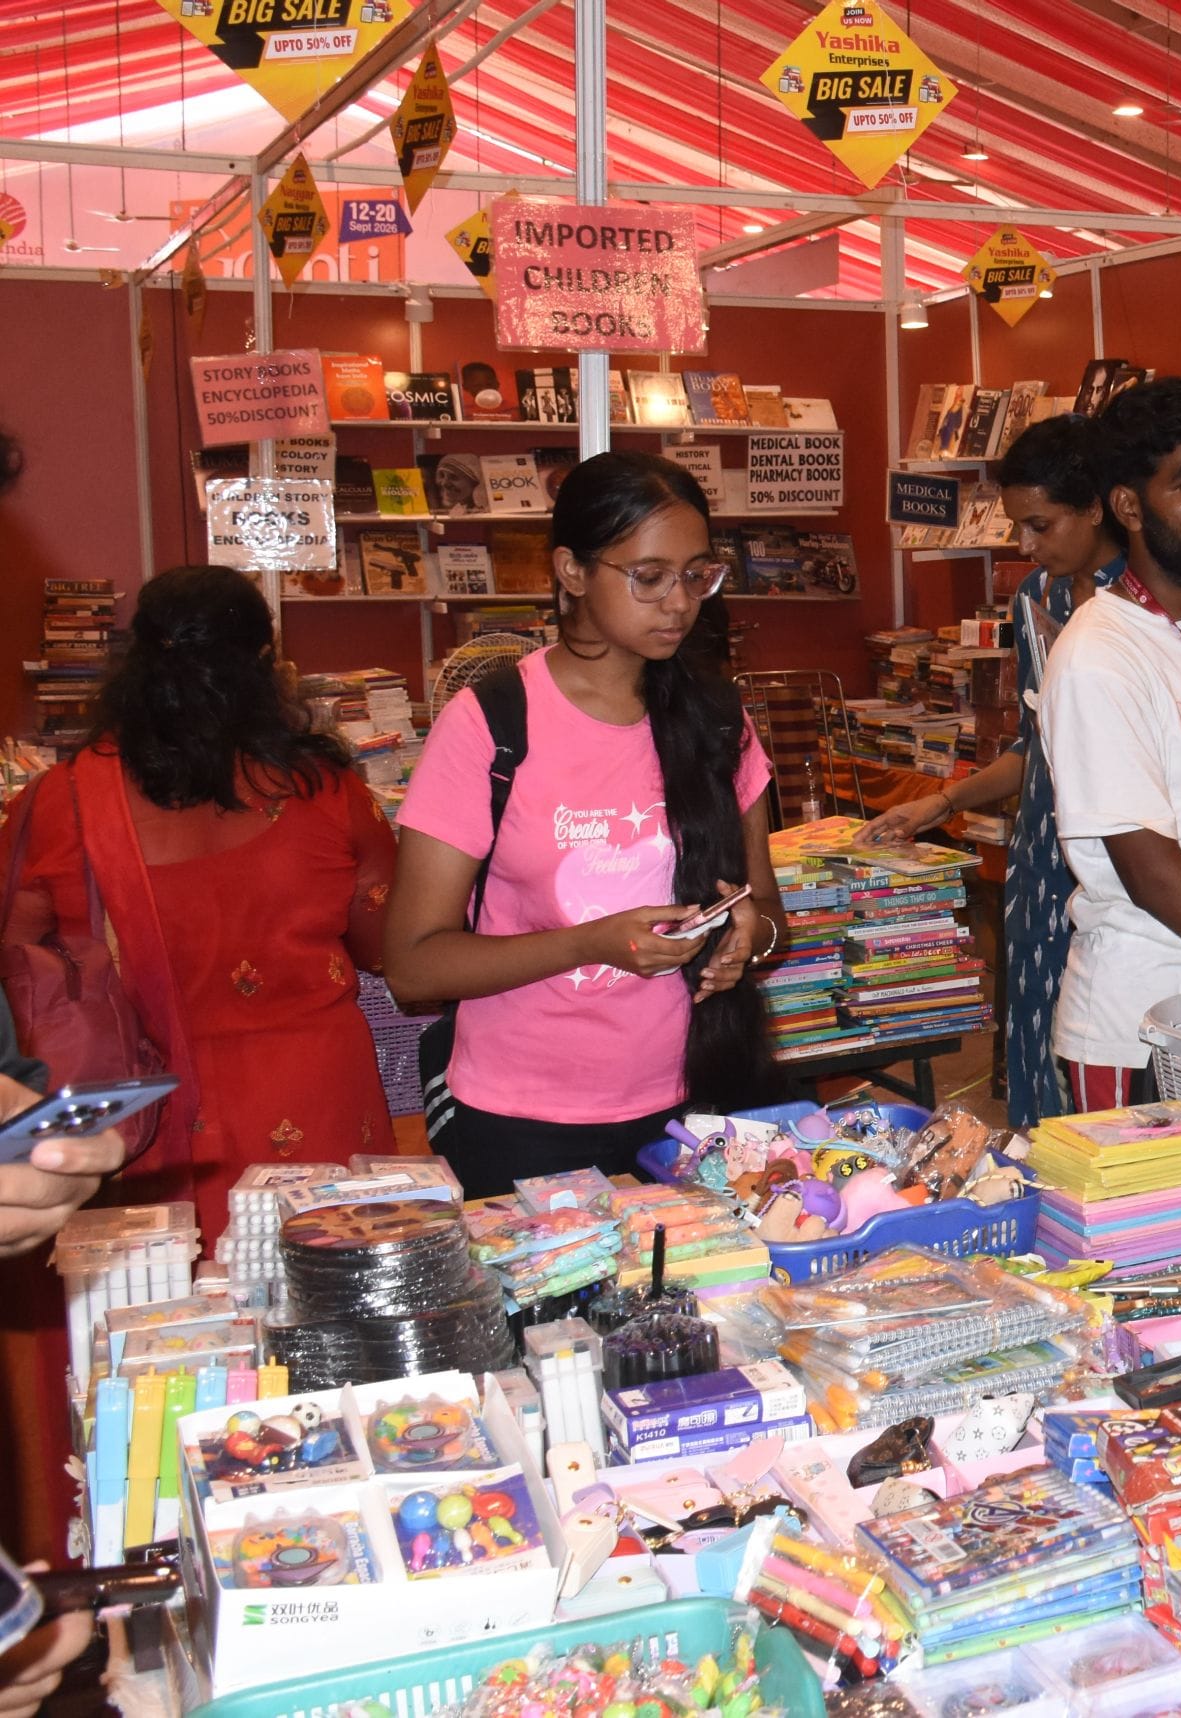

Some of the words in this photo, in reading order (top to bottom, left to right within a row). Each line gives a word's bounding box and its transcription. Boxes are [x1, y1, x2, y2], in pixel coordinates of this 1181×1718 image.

[228, 0, 272, 25] BIG
[281, 0, 341, 21] SALE
[855, 17, 872, 25] NOW
[274, 38, 304, 52] UPTO
[306, 38, 331, 50] 50%
[333, 35, 352, 48] OFF
[816, 31, 900, 53] Yashika
[829, 53, 890, 67] Enterprises
[816, 78, 852, 100] BIG
[858, 76, 906, 98] SALE
[853, 115, 876, 126] UPTO
[899, 113, 913, 123] OFF
[349, 202, 396, 221] 12-20
[349, 222, 372, 233] Sept
[374, 223, 398, 234] 2026
[515, 219, 674, 253] IMPORTED
[988, 247, 1030, 258] Yashika
[524, 266, 670, 297] CHILDREN
[987, 270, 1006, 283] BIG
[1008, 268, 1032, 281] SALE
[552, 310, 652, 338] BOOKS
[203, 367, 253, 382] STORY
[258, 362, 311, 378] BOOKS
[202, 384, 318, 404] ENCYCLOPEDIA
[692, 381, 729, 392] BODY
[207, 404, 319, 425] 50%DISCOUNT
[290, 438, 330, 447] BOOKS
[751, 438, 800, 450] MEDICAL
[805, 437, 840, 449] BOOK
[676, 450, 710, 459] HISTORY
[751, 454, 794, 467] DENTAL
[799, 453, 840, 466] BOOKS
[750, 468, 803, 483] PHARMACY
[806, 468, 841, 481] BOOKS
[284, 493, 328, 502] STORY
[751, 491, 775, 503] 50%
[779, 489, 840, 503] DISCOUNT
[897, 483, 951, 500] MEDICAL
[902, 500, 946, 516] BOOKS
[573, 809, 589, 818] YOU
[590, 809, 603, 817] ARE
[603, 808, 618, 816] THE
[554, 806, 610, 840] Creator
[558, 840, 569, 849] OF
[850, 881, 869, 890] my
[869, 875, 889, 887] first
[635, 1429, 667, 1442] K1410
